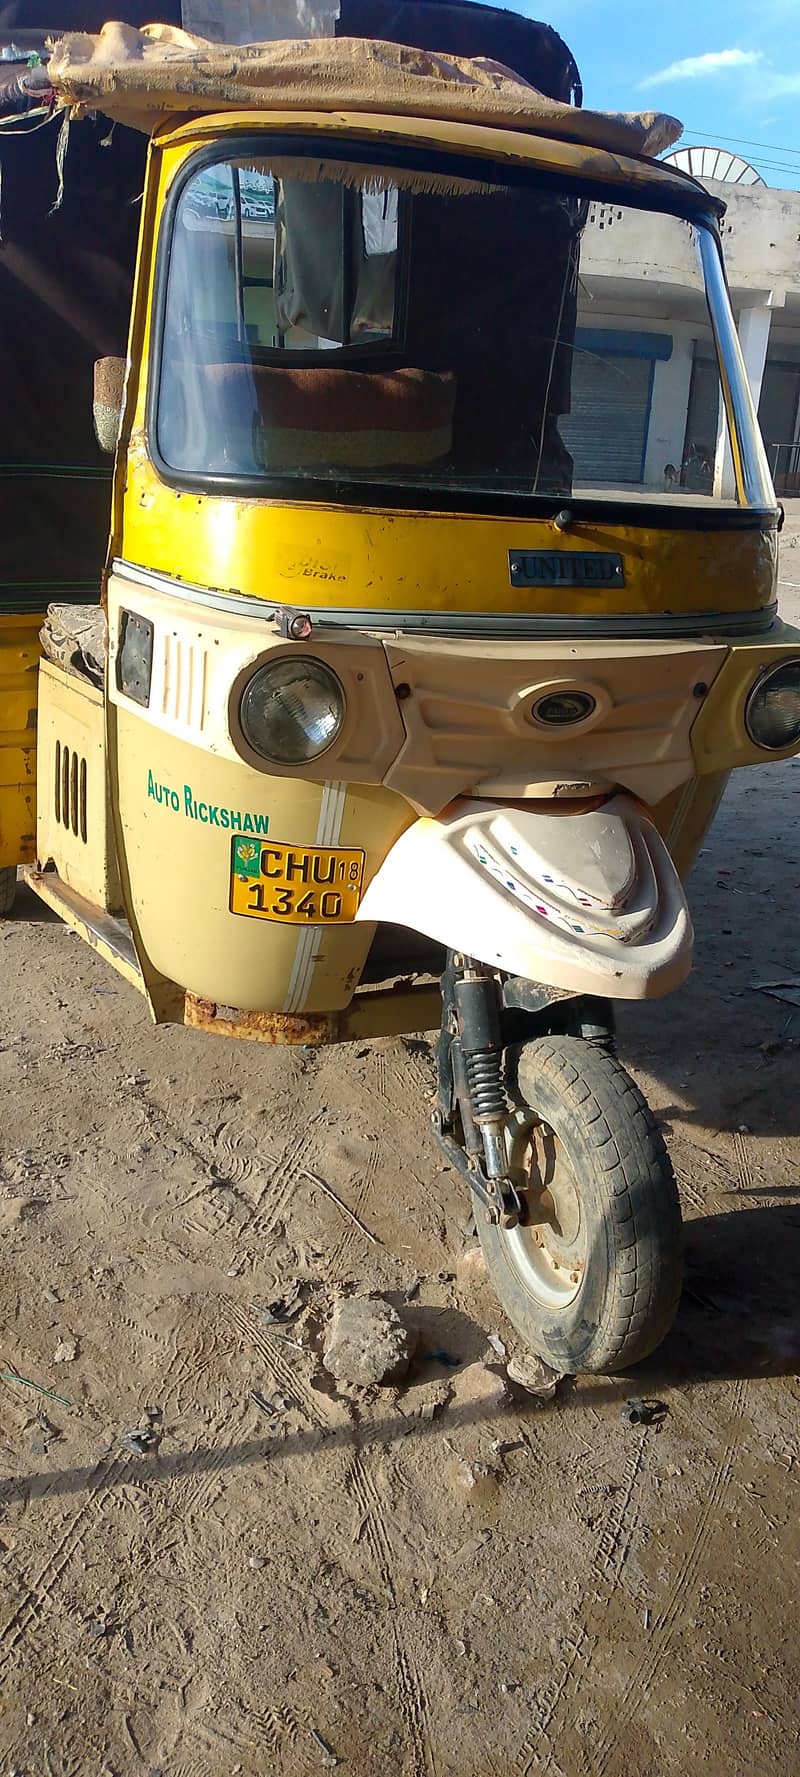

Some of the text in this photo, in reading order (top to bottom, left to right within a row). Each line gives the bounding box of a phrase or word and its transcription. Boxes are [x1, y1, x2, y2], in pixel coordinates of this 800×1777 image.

[302, 568, 347, 582] Brake
[519, 556, 615, 580] UNITED
[260, 849, 359, 883] CHU 18
[247, 883, 342, 918] 1340
